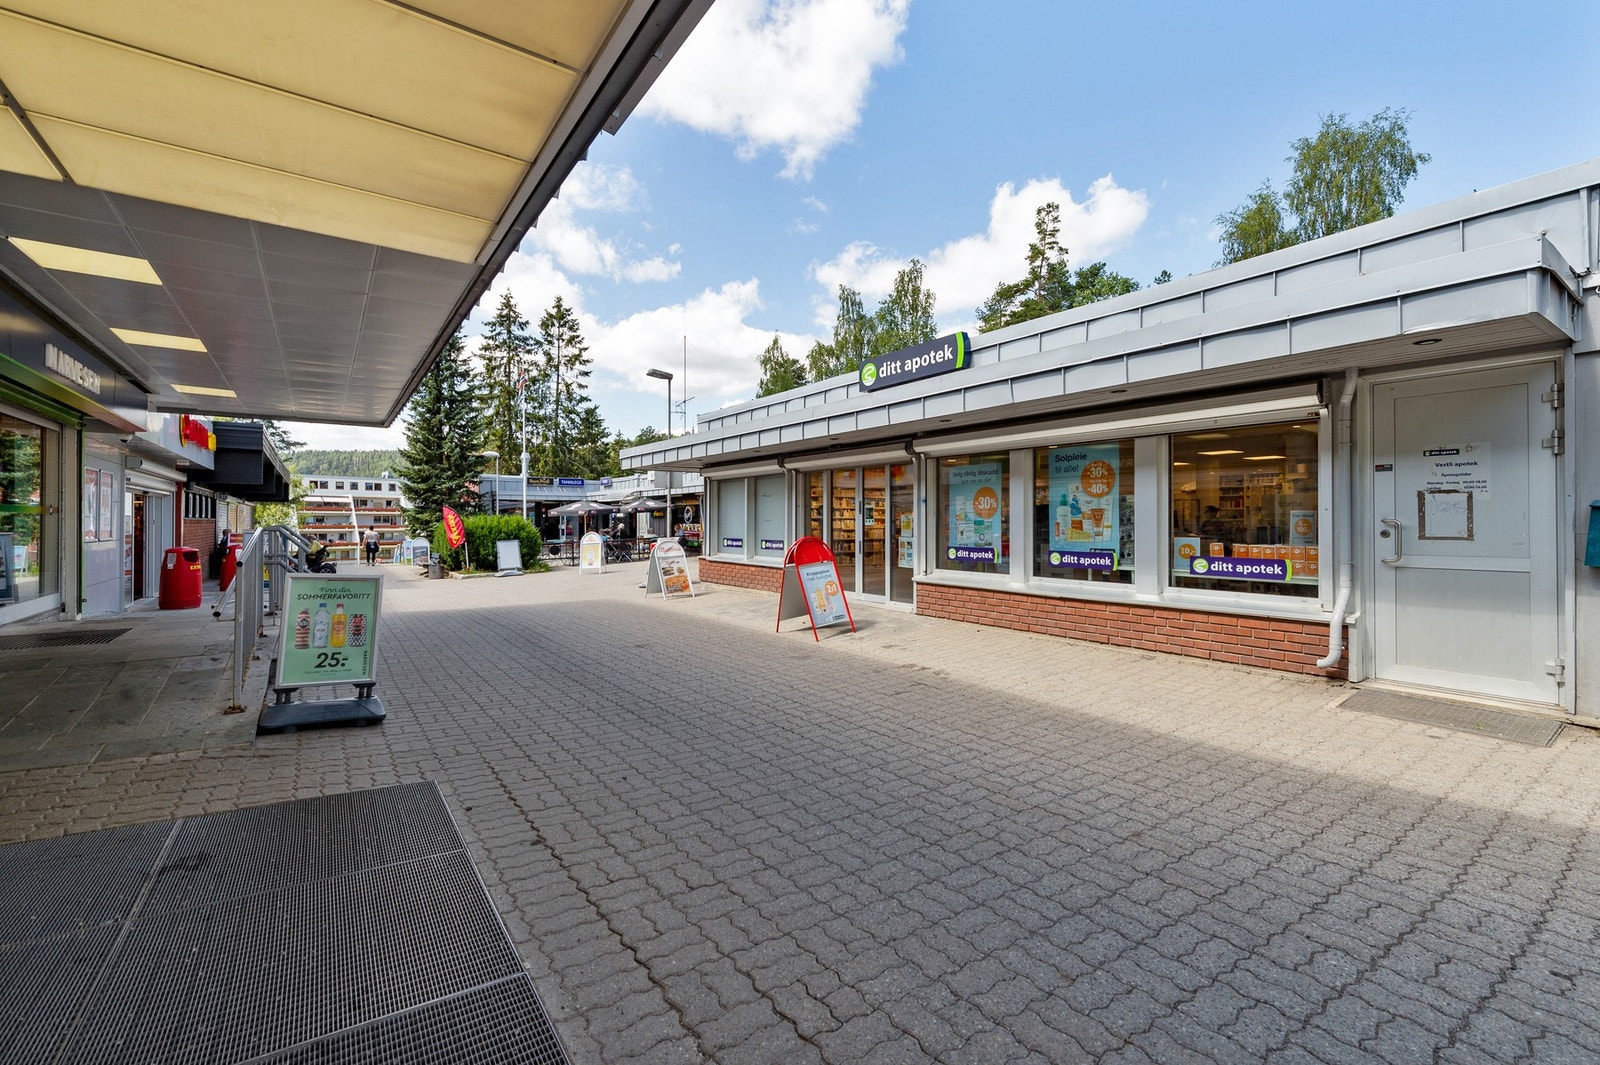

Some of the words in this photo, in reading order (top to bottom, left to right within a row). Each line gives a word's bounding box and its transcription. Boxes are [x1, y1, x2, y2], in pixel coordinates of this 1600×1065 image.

[879, 360, 901, 378] ditt
[904, 344, 954, 373] apotek
[45, 343, 100, 395] NARVESEN
[1055, 452, 1087, 463] Solpleie
[1064, 464, 1079, 473] alle!
[1087, 467, 1108, 478] -30%
[1088, 483, 1108, 494] -40%
[975, 496, 997, 509] -30%
[970, 551, 993, 559] apotek
[1062, 554, 1078, 563] ditt
[1079, 556, 1111, 565] apotek
[1210, 561, 1233, 571] ditt
[1236, 564, 1282, 574] apotek
